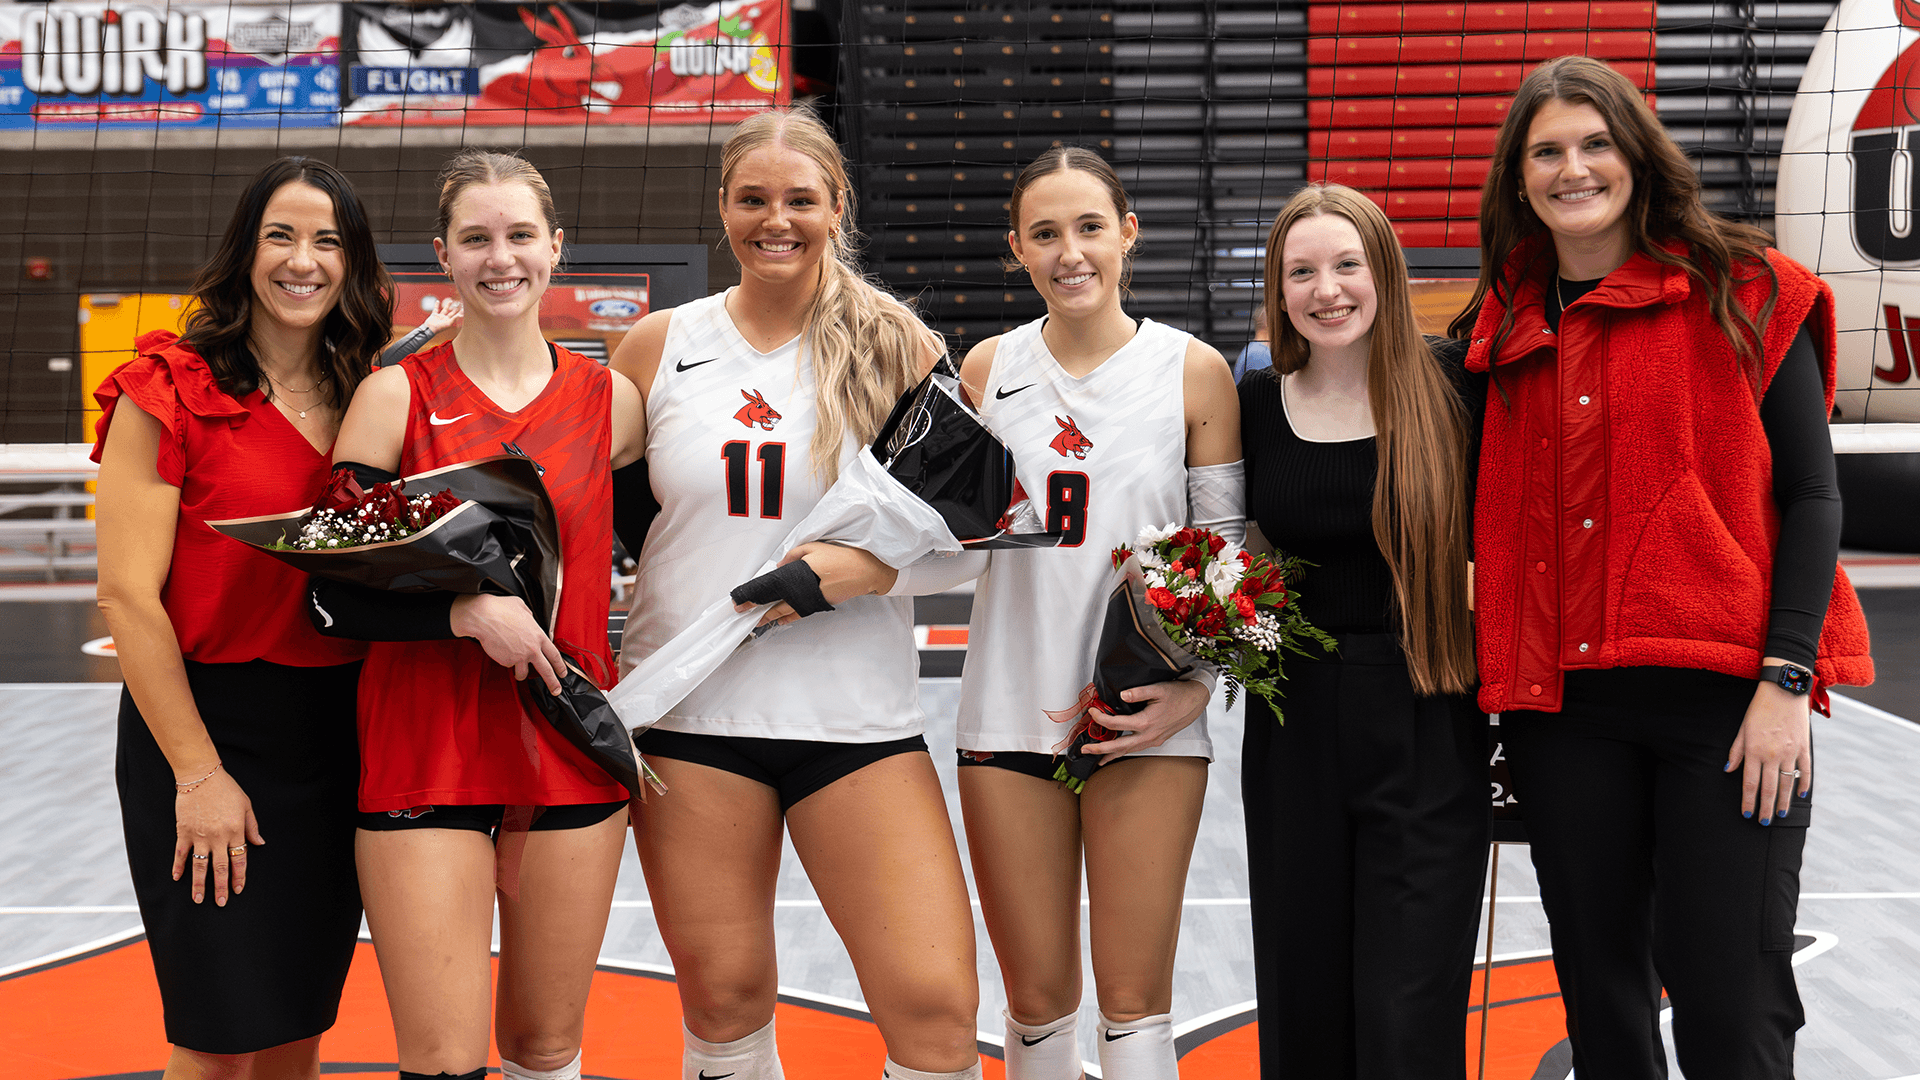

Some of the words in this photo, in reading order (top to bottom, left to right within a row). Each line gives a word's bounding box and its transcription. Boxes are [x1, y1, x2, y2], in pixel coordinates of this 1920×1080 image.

[367, 70, 464, 92] FLIGHT
[720, 440, 787, 520] 11
[1045, 470, 1090, 548] 8
